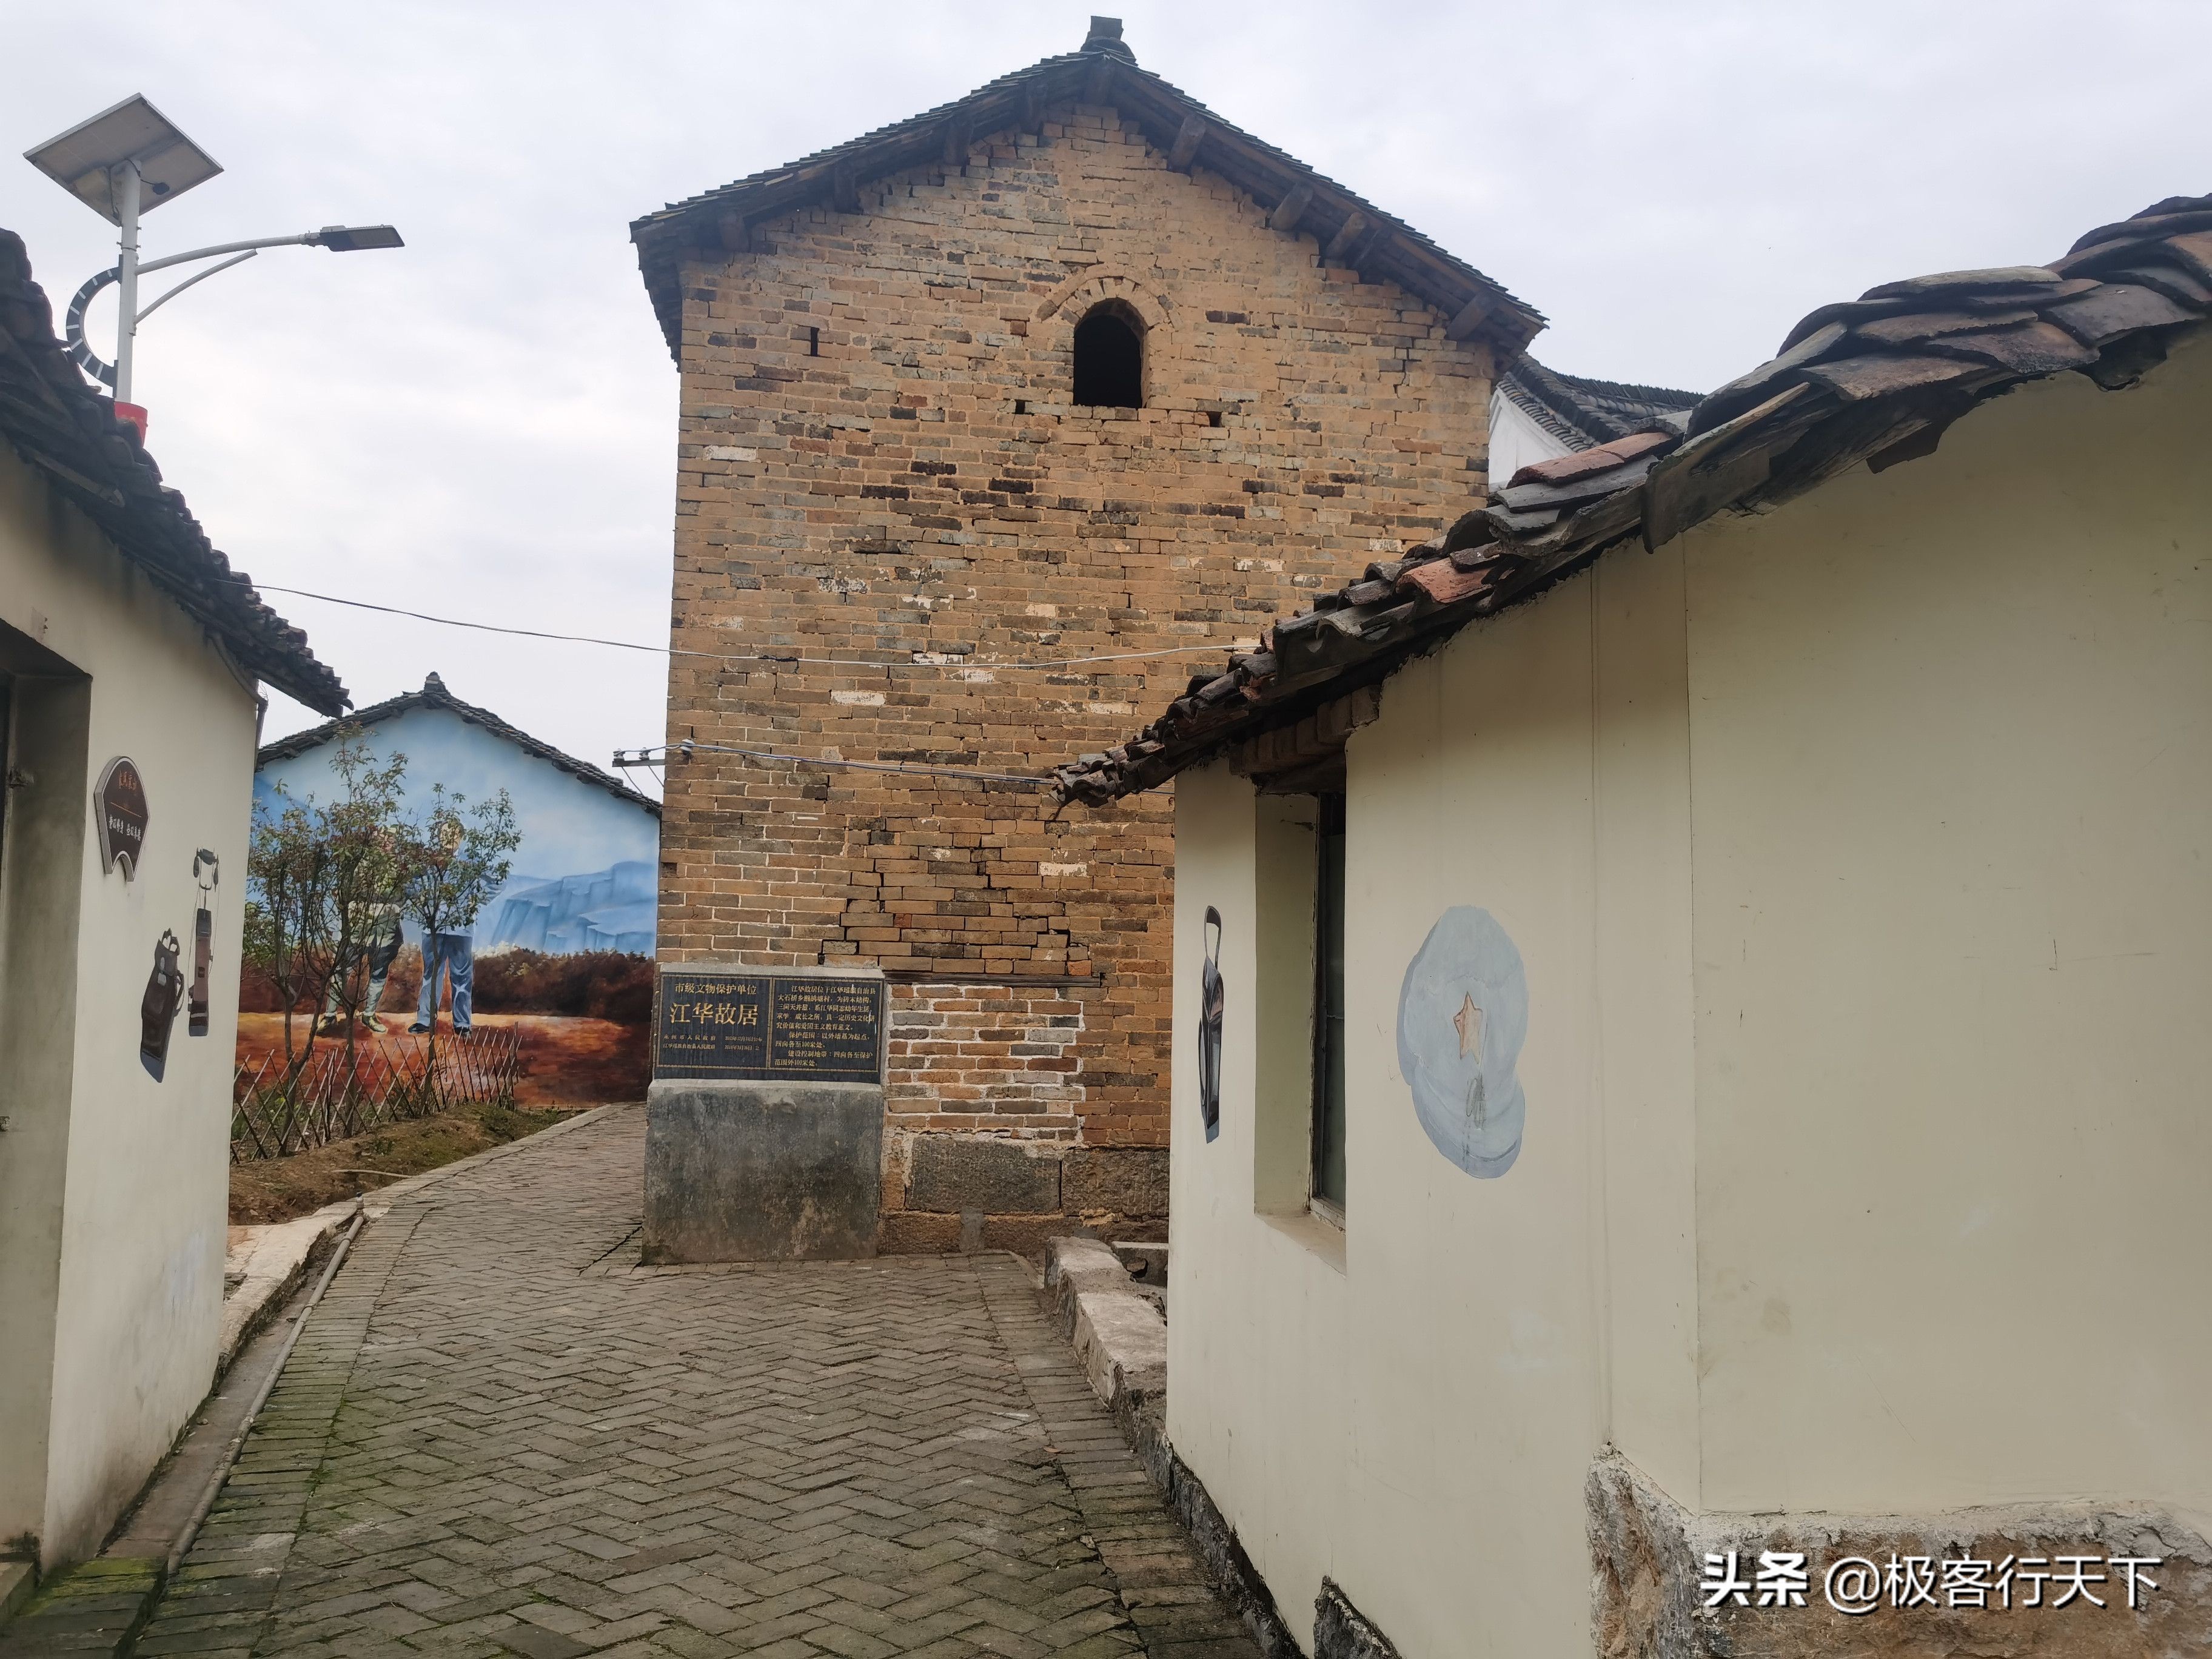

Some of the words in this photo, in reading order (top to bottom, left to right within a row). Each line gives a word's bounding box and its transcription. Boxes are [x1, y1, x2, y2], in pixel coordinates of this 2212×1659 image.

[675, 982, 757, 995] 市级文物保护单位
[669, 1002, 759, 1026] 江华故居
